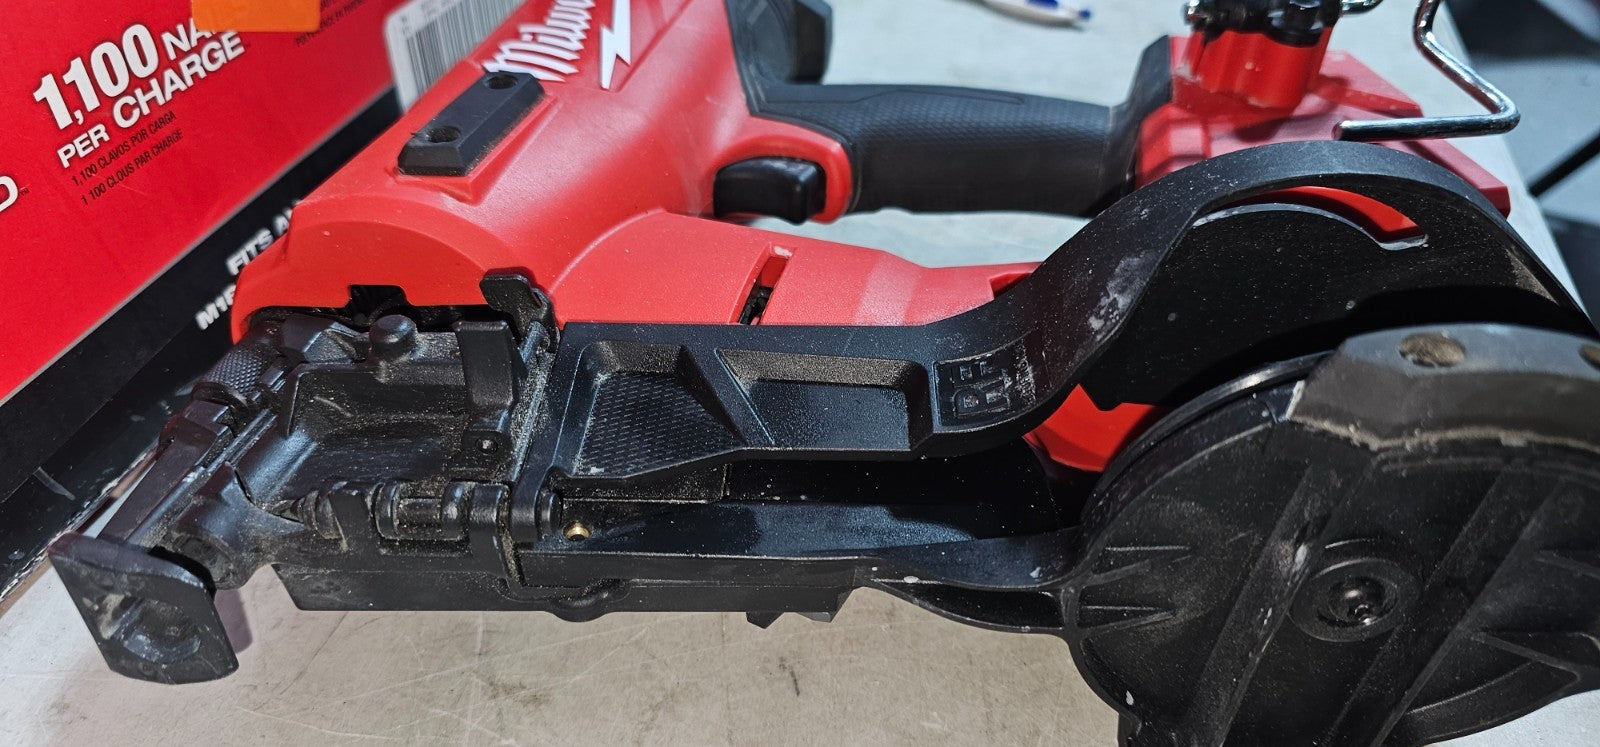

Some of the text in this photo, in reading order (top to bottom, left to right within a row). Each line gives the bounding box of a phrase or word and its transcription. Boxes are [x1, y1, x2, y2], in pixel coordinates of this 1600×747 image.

[33, 24, 159, 130] 1,100
[161, 17, 216, 61] NA
[57, 30, 246, 168] PER CHARGE
[72, 110, 176, 186] 1,100 CLAVOS POR CARGA
[106, 162, 135, 189] CLOUS
[134, 150, 152, 169] PAR
[150, 128, 184, 157] CHARGE
[226, 227, 274, 275] FITS
